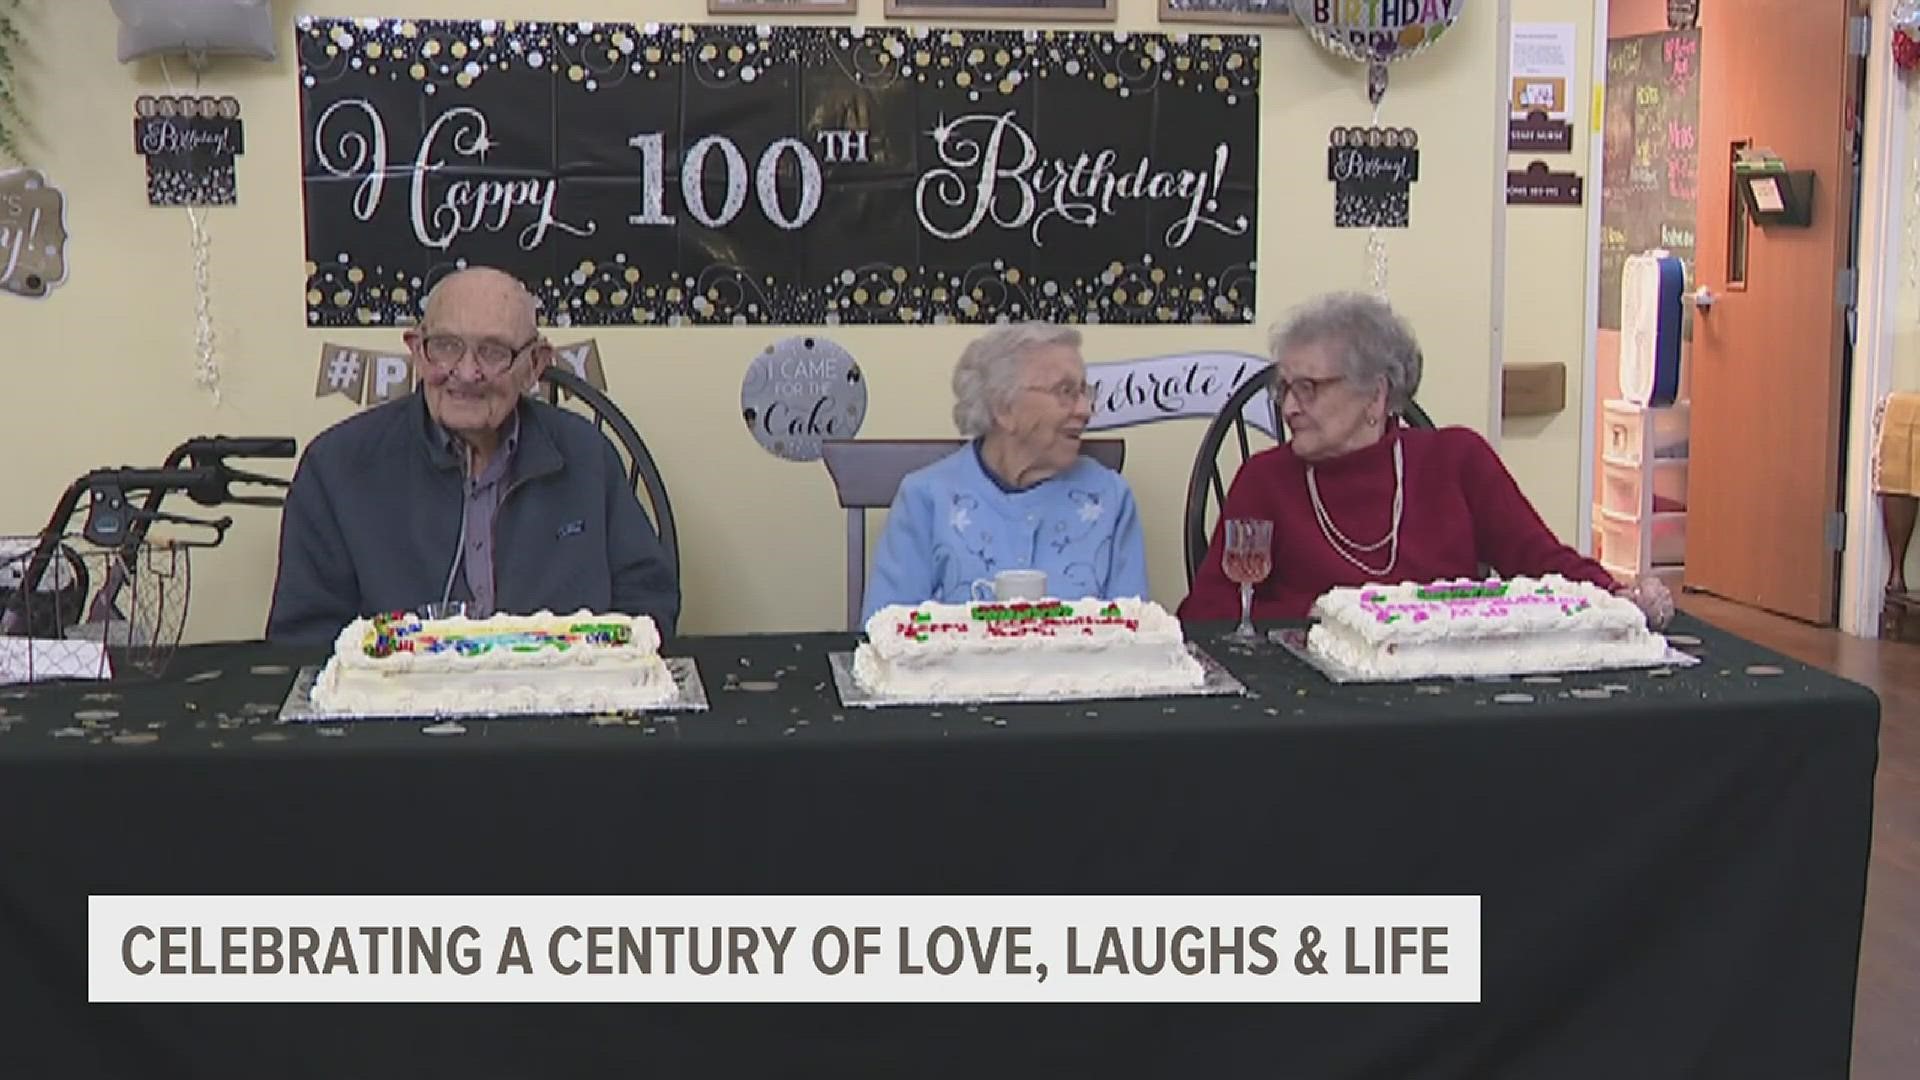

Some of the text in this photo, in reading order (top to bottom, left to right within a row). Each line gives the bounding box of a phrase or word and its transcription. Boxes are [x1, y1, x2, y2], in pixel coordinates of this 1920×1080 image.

[1314, 0, 1451, 27] BIRTHDAY
[140, 98, 234, 116] HAPPY
[1333, 129, 1414, 147] HAPPY
[315, 99, 595, 250] Happy
[915, 109, 1248, 248] Birthday!
[780, 359, 838, 379] CAME
[764, 396, 838, 436] Cake
